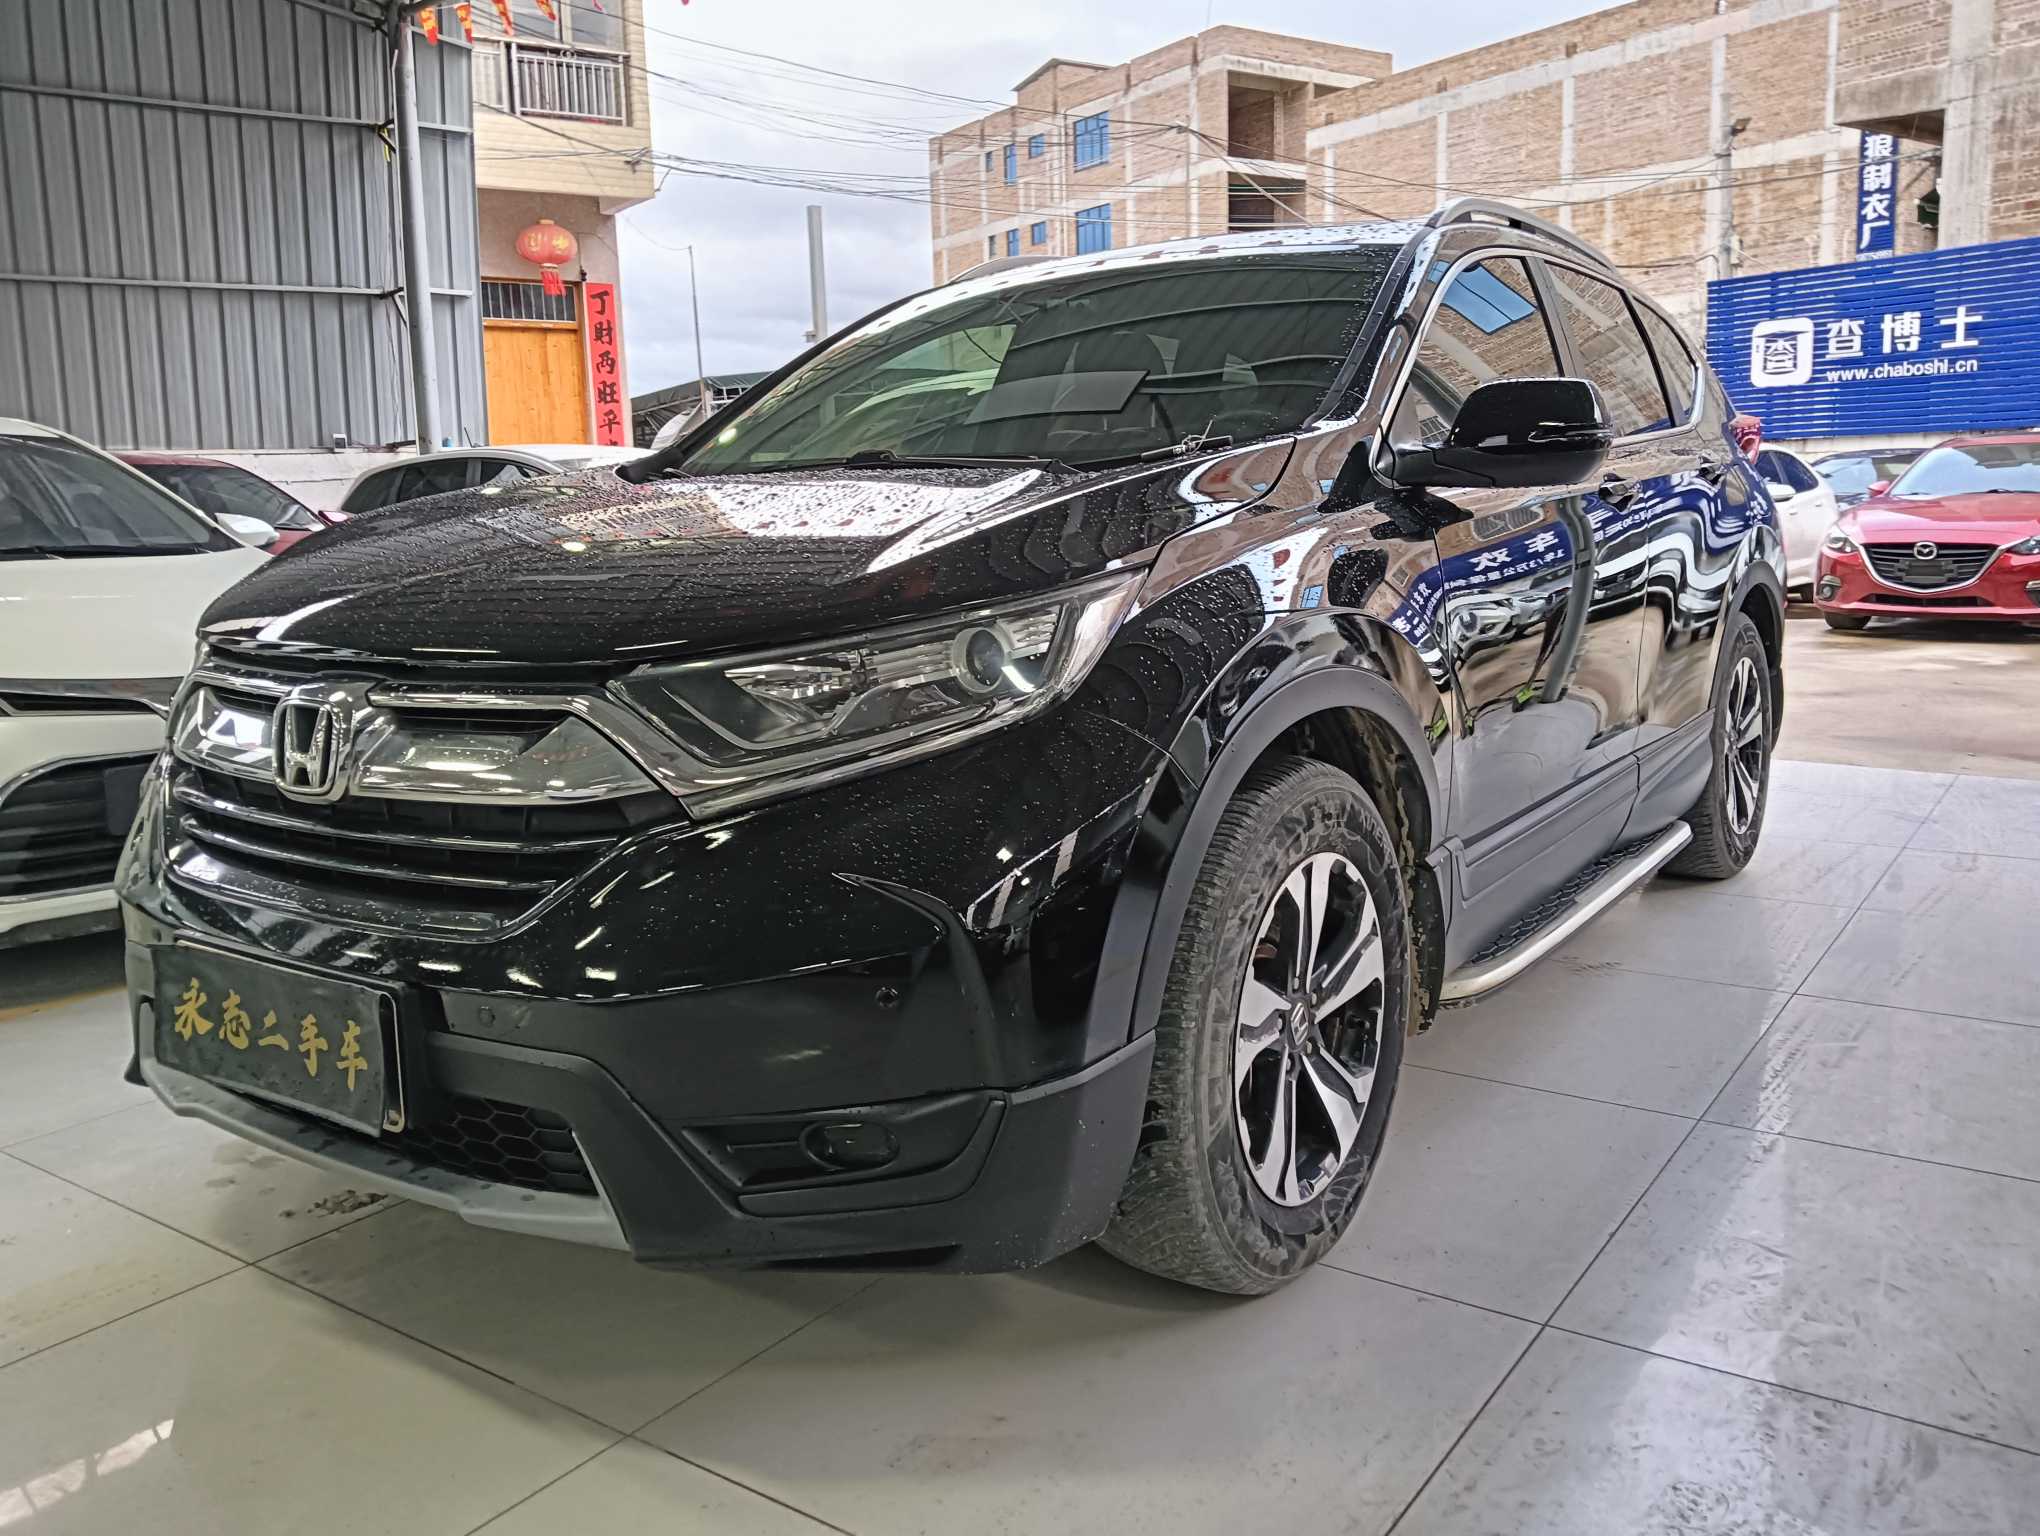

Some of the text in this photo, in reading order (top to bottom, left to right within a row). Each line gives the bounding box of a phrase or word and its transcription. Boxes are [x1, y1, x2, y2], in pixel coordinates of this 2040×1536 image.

[1825, 306, 1983, 359] 查博士
[1825, 358, 1978, 383] www.chaboshi.cn
